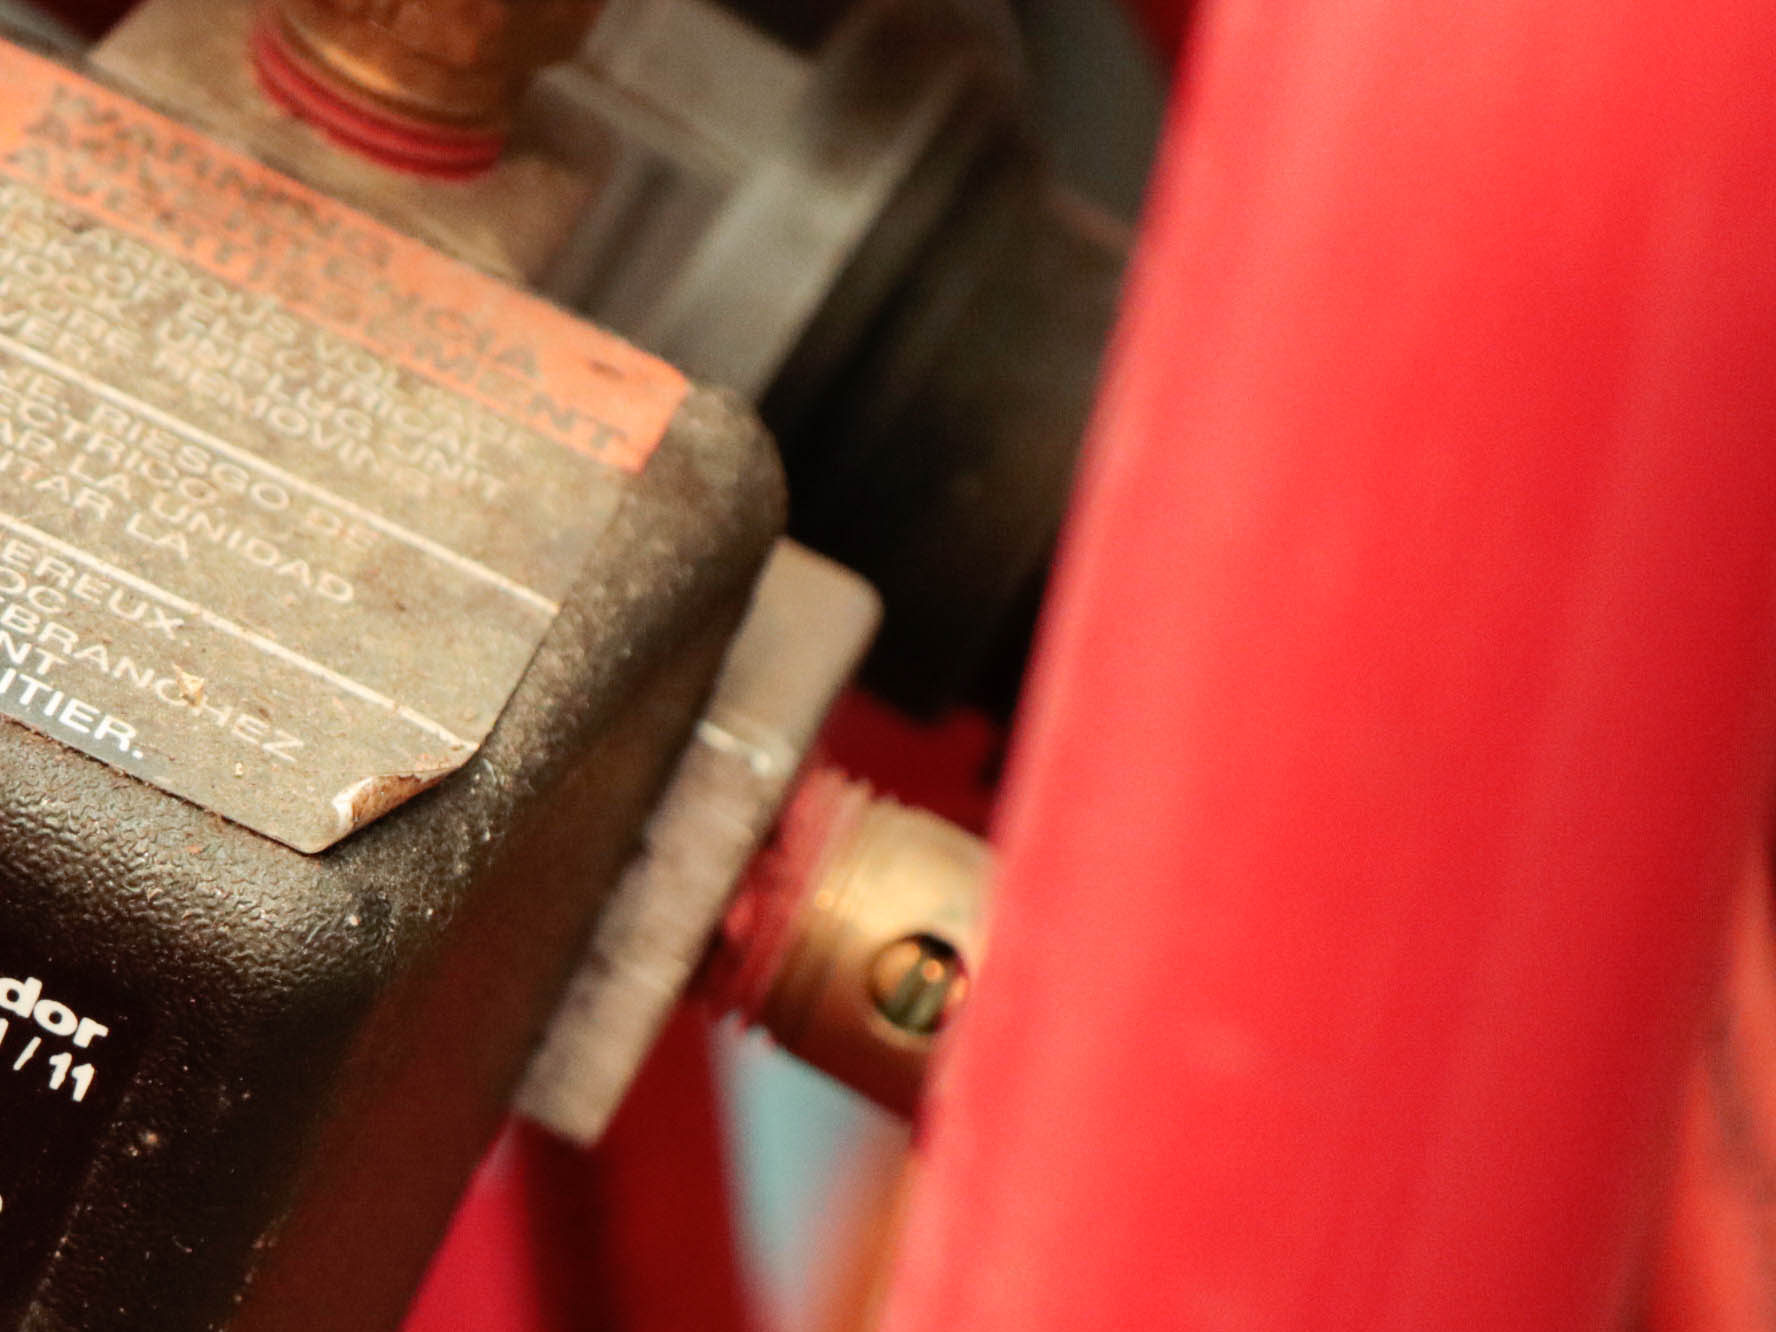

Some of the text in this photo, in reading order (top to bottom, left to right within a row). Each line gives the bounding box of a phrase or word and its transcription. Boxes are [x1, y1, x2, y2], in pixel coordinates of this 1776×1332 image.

[87, 258, 174, 312] OF
[145, 347, 440, 501] REMOVING
[149, 319, 380, 441] UNPLUG
[64, 452, 141, 503] LA
[143, 490, 360, 607] UNIDAD
[86, 402, 297, 516] RIESGO
[298, 503, 380, 555] DE
[121, 509, 201, 562] LA
